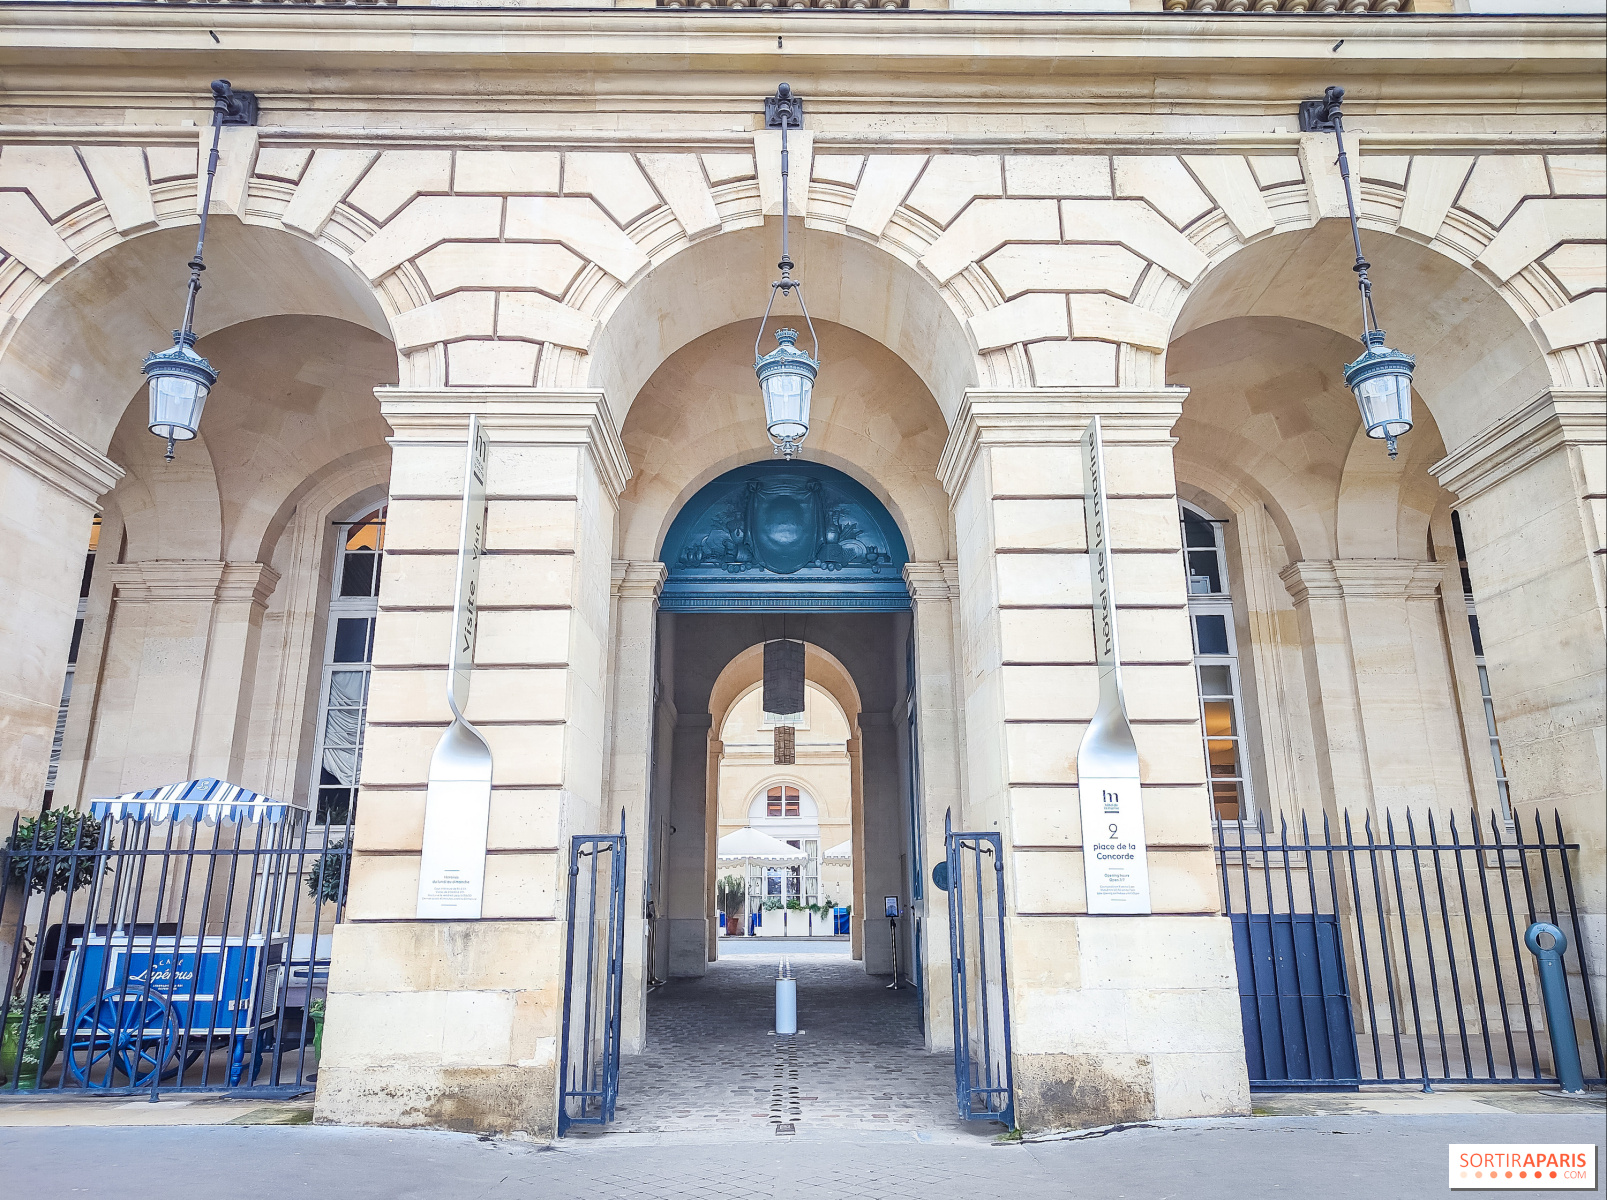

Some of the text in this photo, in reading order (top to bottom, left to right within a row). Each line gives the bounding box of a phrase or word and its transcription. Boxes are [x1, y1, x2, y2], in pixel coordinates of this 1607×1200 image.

[1087, 431, 1112, 656] hôtel de la marine
[462, 522, 481, 654] Visite Visit
[1108, 823, 1119, 839] 2
[1093, 842, 1115, 851] place
[1096, 852, 1135, 860] Concorde
